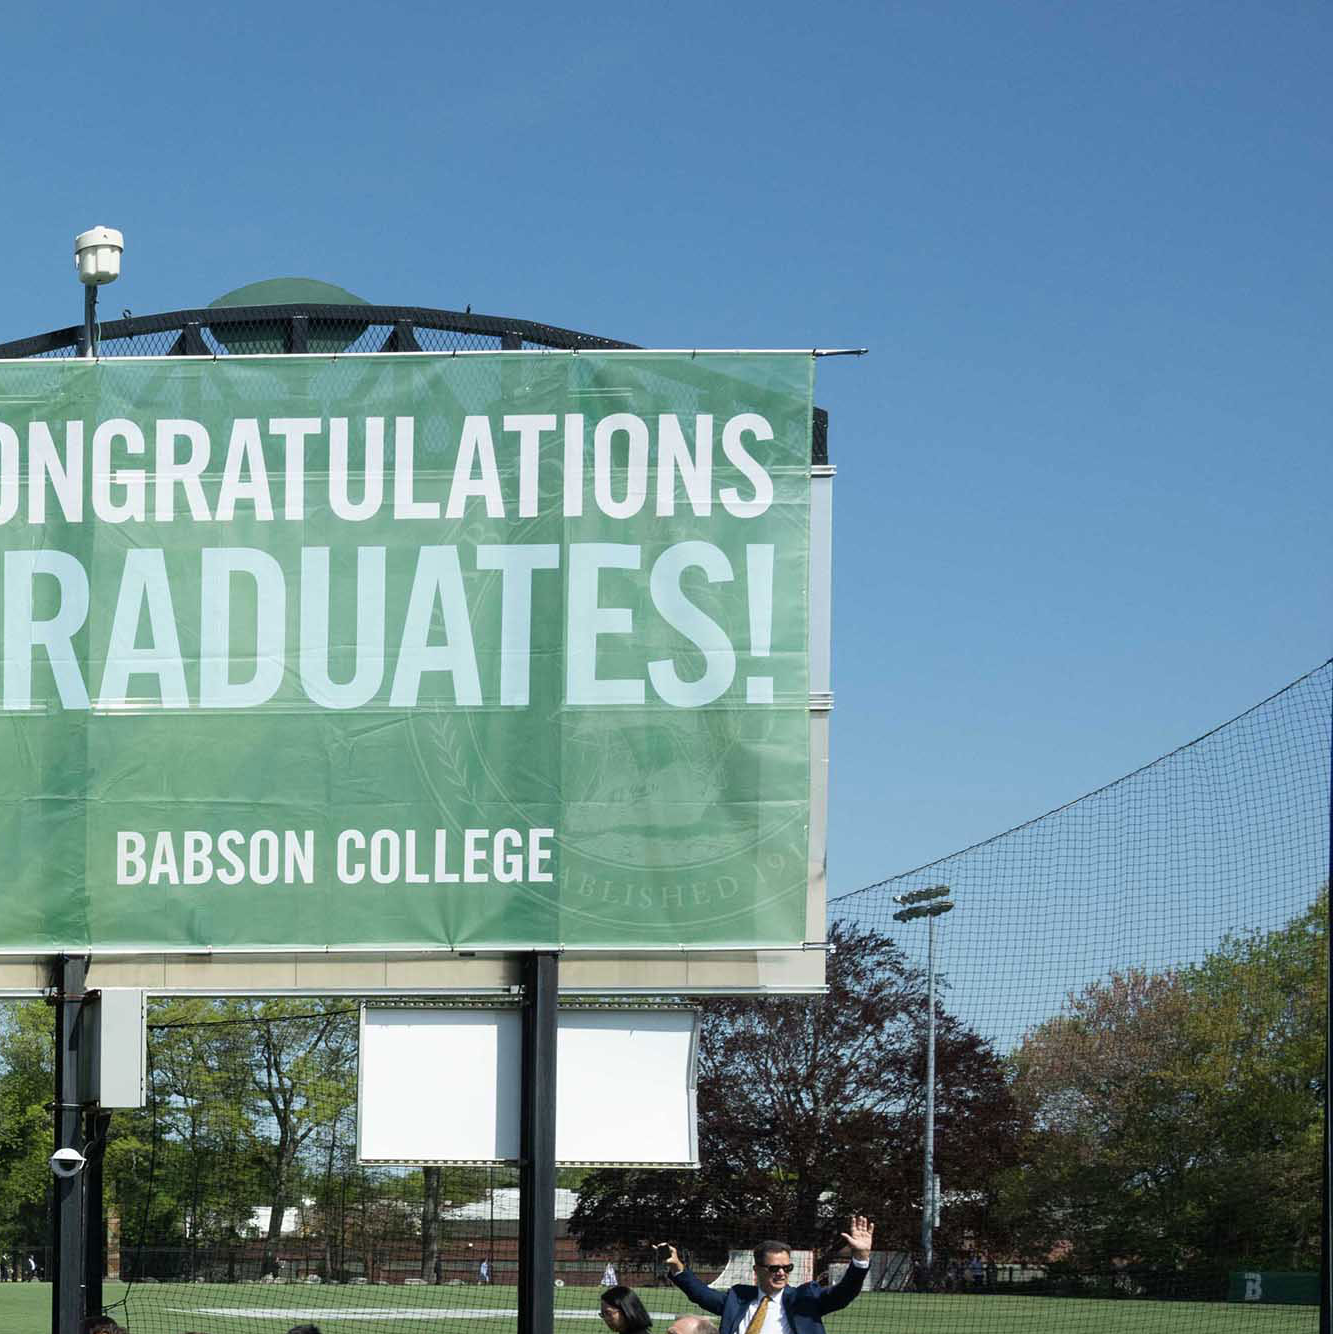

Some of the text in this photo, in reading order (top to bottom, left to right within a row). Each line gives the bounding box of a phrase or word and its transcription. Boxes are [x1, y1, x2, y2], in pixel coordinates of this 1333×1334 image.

[116, 828, 555, 886] BABSON COLLEGE
[539, 861, 741, 908] ABLISHED
